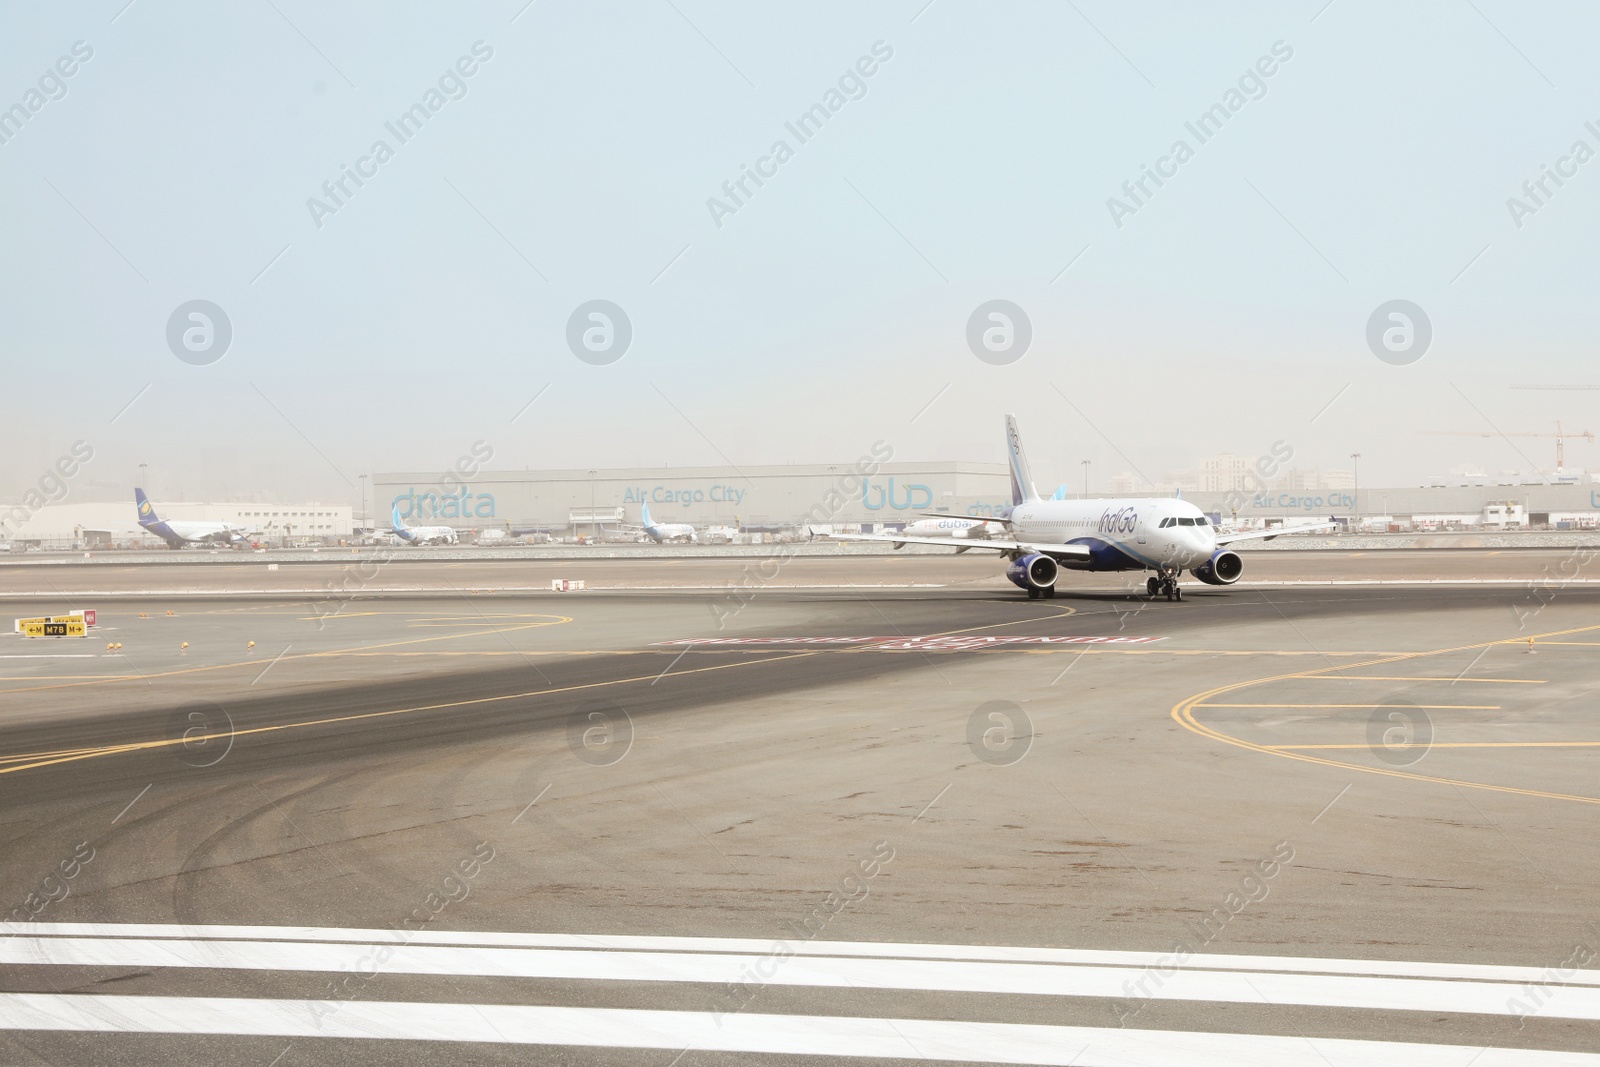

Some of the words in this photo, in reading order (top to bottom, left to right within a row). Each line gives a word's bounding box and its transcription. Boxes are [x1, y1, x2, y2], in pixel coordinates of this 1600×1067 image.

[392, 486, 496, 518] dnata
[623, 486, 647, 503] Air
[652, 486, 704, 507] Cargo
[709, 485, 745, 505] City
[1253, 495, 1274, 508] Air
[1278, 494, 1324, 511] Cargo
[1327, 493, 1356, 510] City
[1098, 506, 1138, 533] IndiGo
